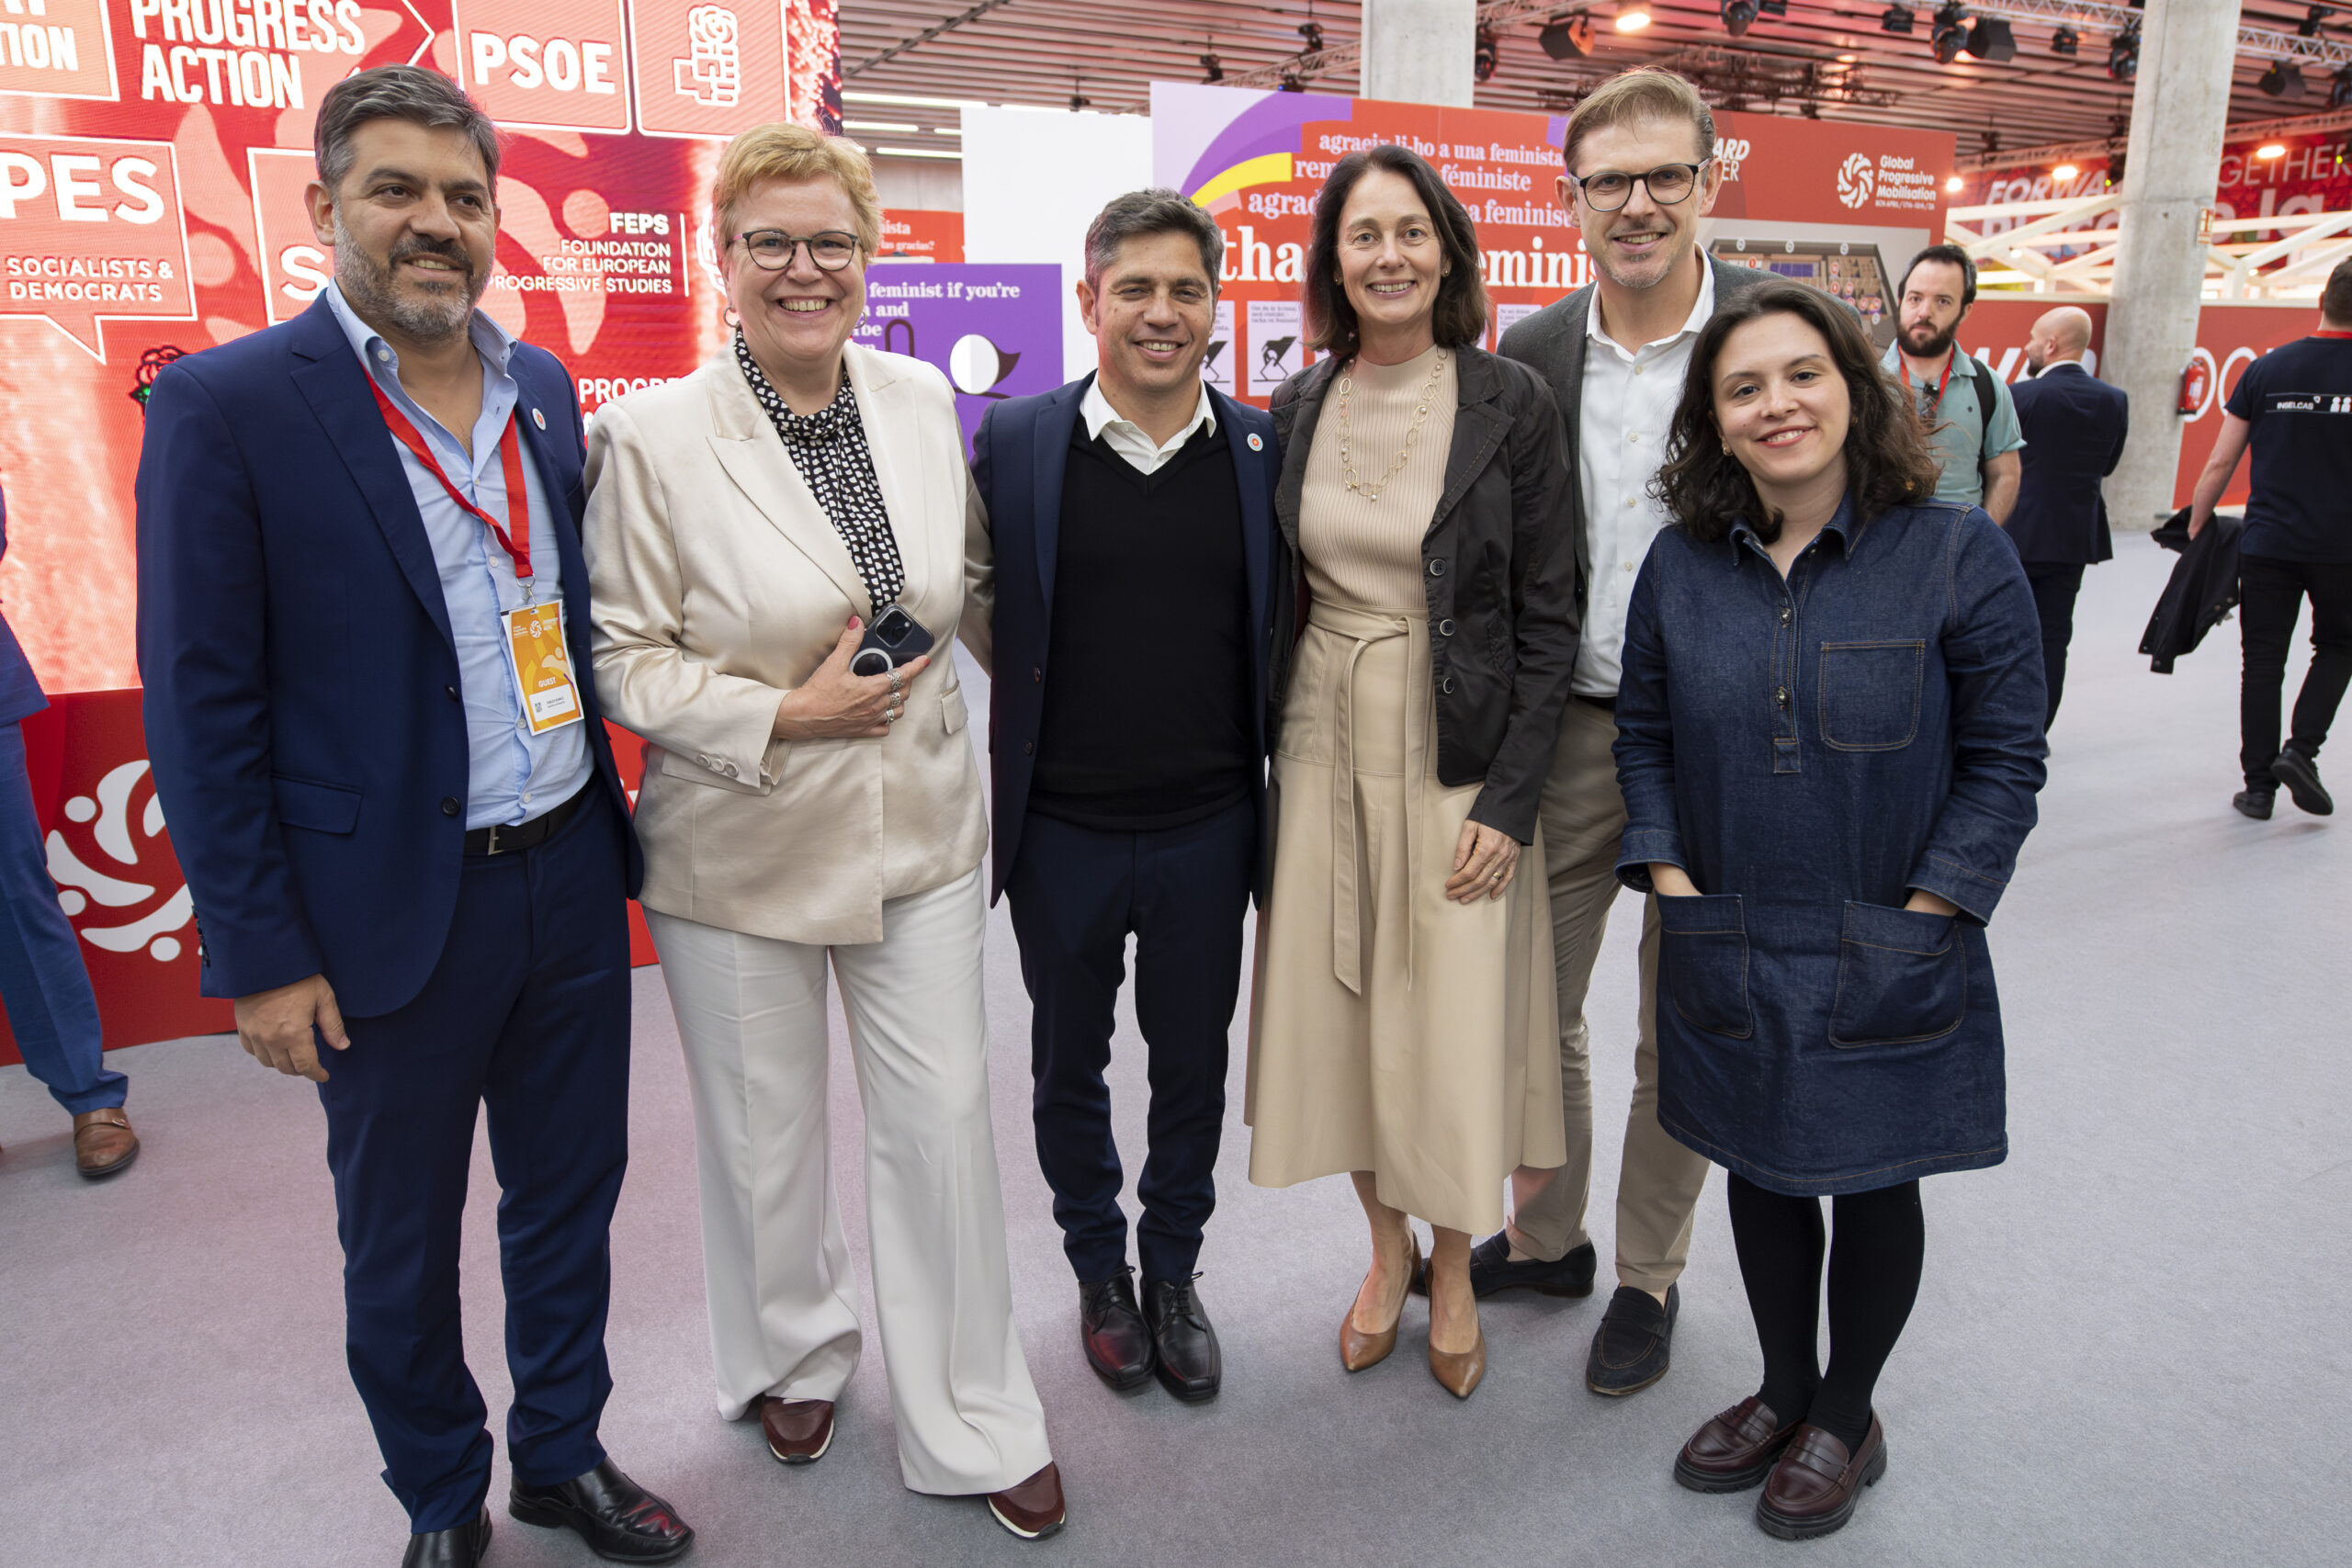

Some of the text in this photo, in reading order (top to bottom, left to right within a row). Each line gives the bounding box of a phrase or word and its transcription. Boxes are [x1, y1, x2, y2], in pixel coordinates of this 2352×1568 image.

[131, 0, 366, 55] PROGRESS
[469, 32, 616, 94] PSOE
[141, 43, 304, 109] ACTION
[1439, 142, 1450, 158] a
[1453, 144, 1486, 160] una
[1489, 142, 1563, 167] feminista
[1880, 154, 1914, 170] Global
[1440, 163, 1532, 191] féministe
[1878, 168, 1935, 186] Progressive
[0, 152, 165, 225] PES
[1876, 184, 1937, 201] Mobilisation
[609, 212, 671, 235] FEPS
[560, 239, 672, 257] FOUNDATION
[6, 255, 175, 280] SOCIALISTS &
[542, 256, 672, 275] FOR EUROPEAN
[10, 280, 163, 302] DEMOCRATS
[605, 277, 673, 294] STUDIES
[868, 281, 943, 299] feminist
[946, 281, 964, 299] if
[875, 301, 910, 318] and
[537, 676, 557, 688] GUEST
